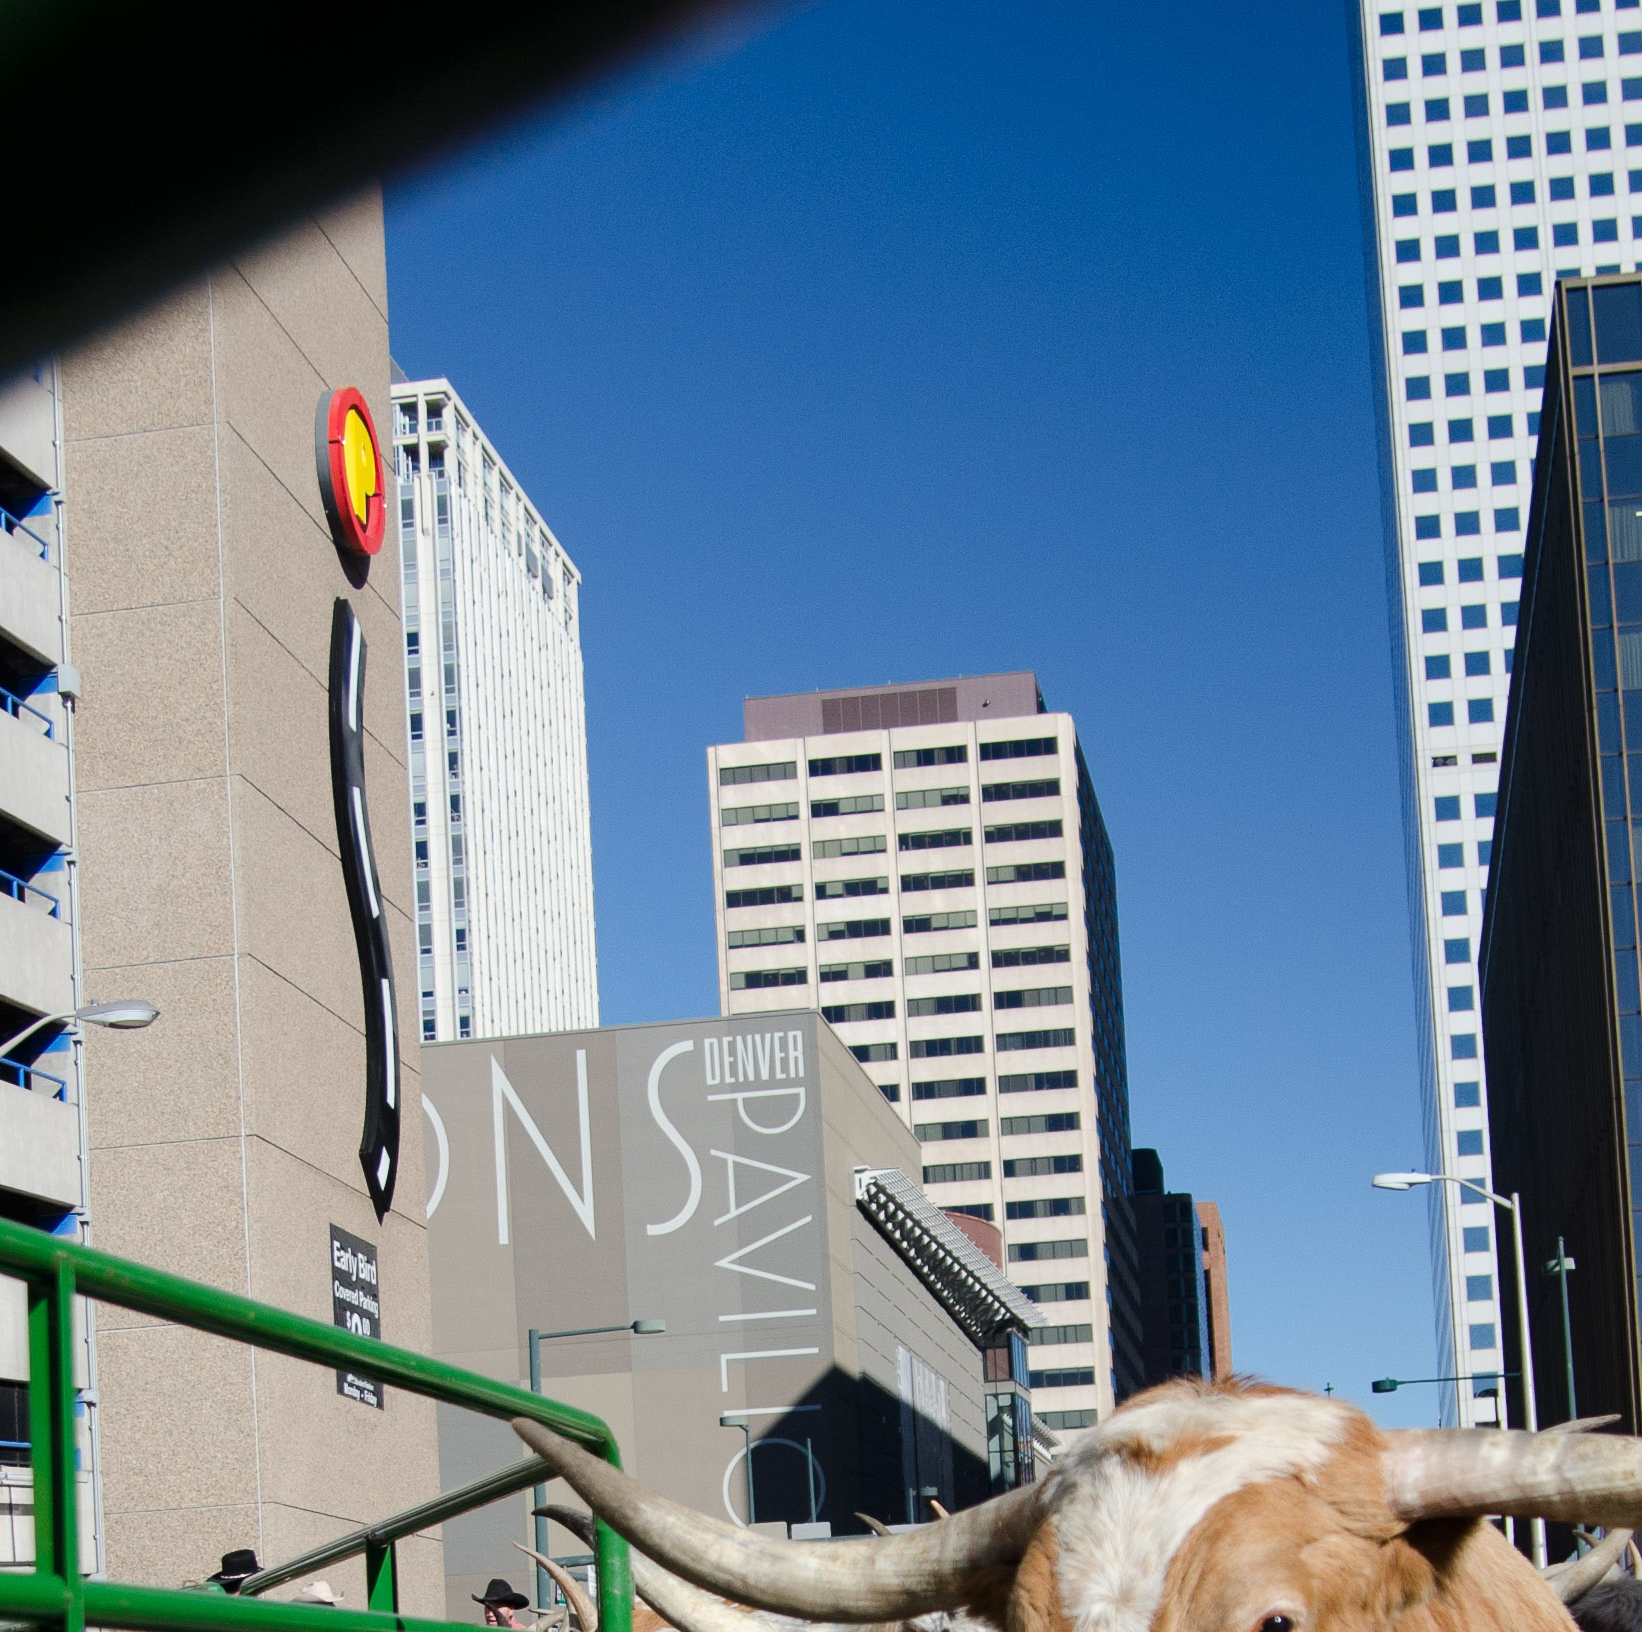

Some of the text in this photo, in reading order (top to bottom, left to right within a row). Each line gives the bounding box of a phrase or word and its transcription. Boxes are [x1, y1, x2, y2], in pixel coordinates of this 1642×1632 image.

[704, 1030, 805, 1085] DENVER
[333, 1239, 377, 1285] Early Bird
[334, 1280, 378, 1319] Covered Parking
